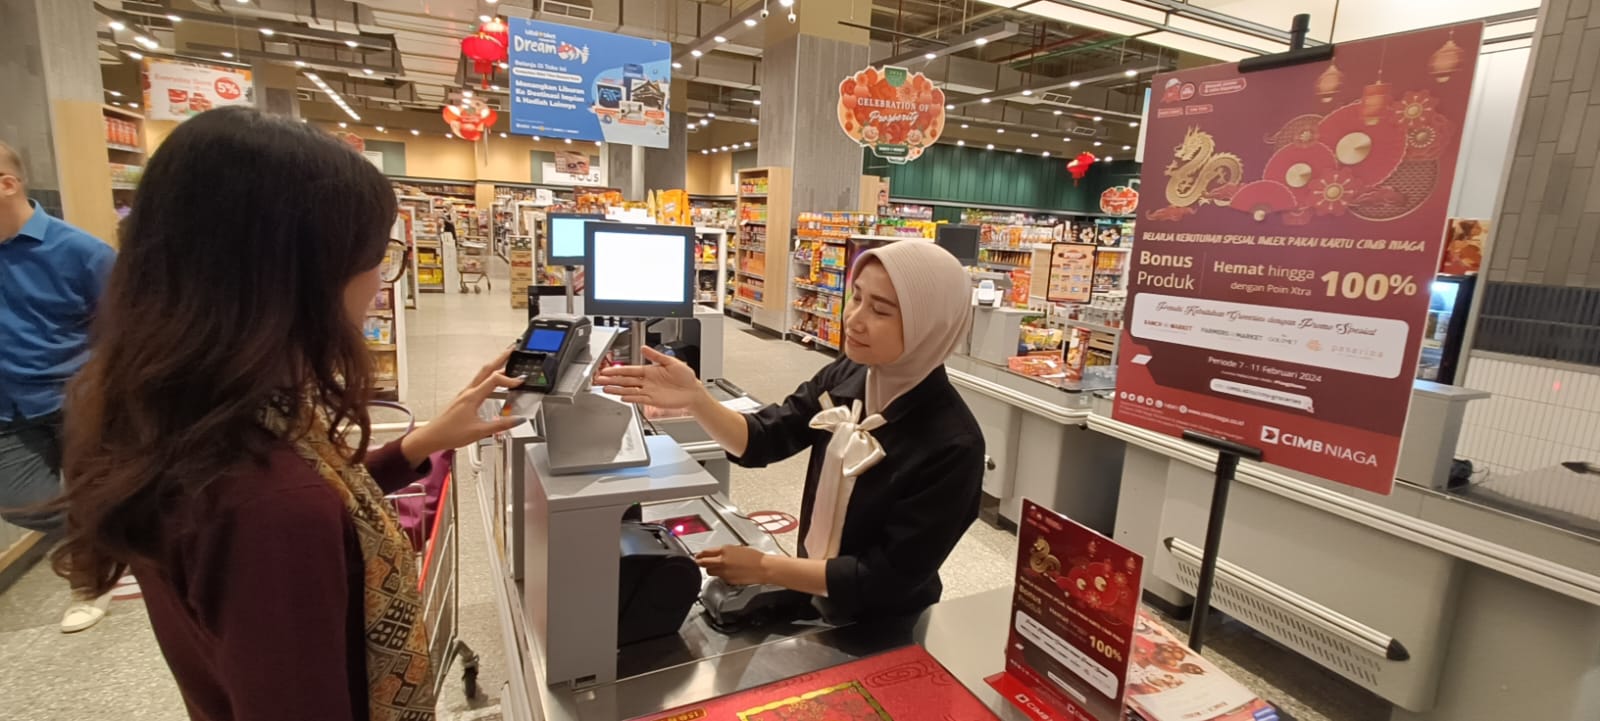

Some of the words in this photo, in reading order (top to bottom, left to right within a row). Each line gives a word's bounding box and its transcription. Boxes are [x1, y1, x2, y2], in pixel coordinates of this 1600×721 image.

[514, 35, 557, 54] Dream
[218, 81, 239, 95] 5%
[559, 85, 585, 94] Liburan
[857, 97, 917, 111] CELEBRATION
[869, 110, 919, 127] Prosperity
[1142, 232, 1174, 242] BELANJA
[1176, 233, 1222, 244] KEBUTUHAN
[1287, 236, 1319, 248] PAKAI
[1320, 237, 1355, 249] KARTU
[1356, 239, 1387, 250] CIMB
[1388, 240, 1426, 252] NIAGA
[1139, 251, 1193, 268] Bonus
[1213, 261, 1264, 276] Hemat
[1268, 265, 1316, 281] hingga
[1137, 271, 1195, 290] Produk
[1230, 282, 1265, 293] dengan
[1267, 283, 1288, 294] Poin
[1290, 286, 1312, 296] Xtra
[1321, 271, 1417, 301] 100%
[1170, 323, 1192, 331] MARKET
[1298, 318, 1333, 330] Promo
[1236, 332, 1263, 341] MARKET
[1208, 356, 1237, 367] Periode
[1251, 364, 1260, 372] 11
[1262, 366, 1298, 378] Februari
[1299, 372, 1322, 382] 2024
[1281, 433, 1323, 453] CIMB
[1325, 443, 1378, 467] NIAGA
[1089, 635, 1122, 662] 100%
